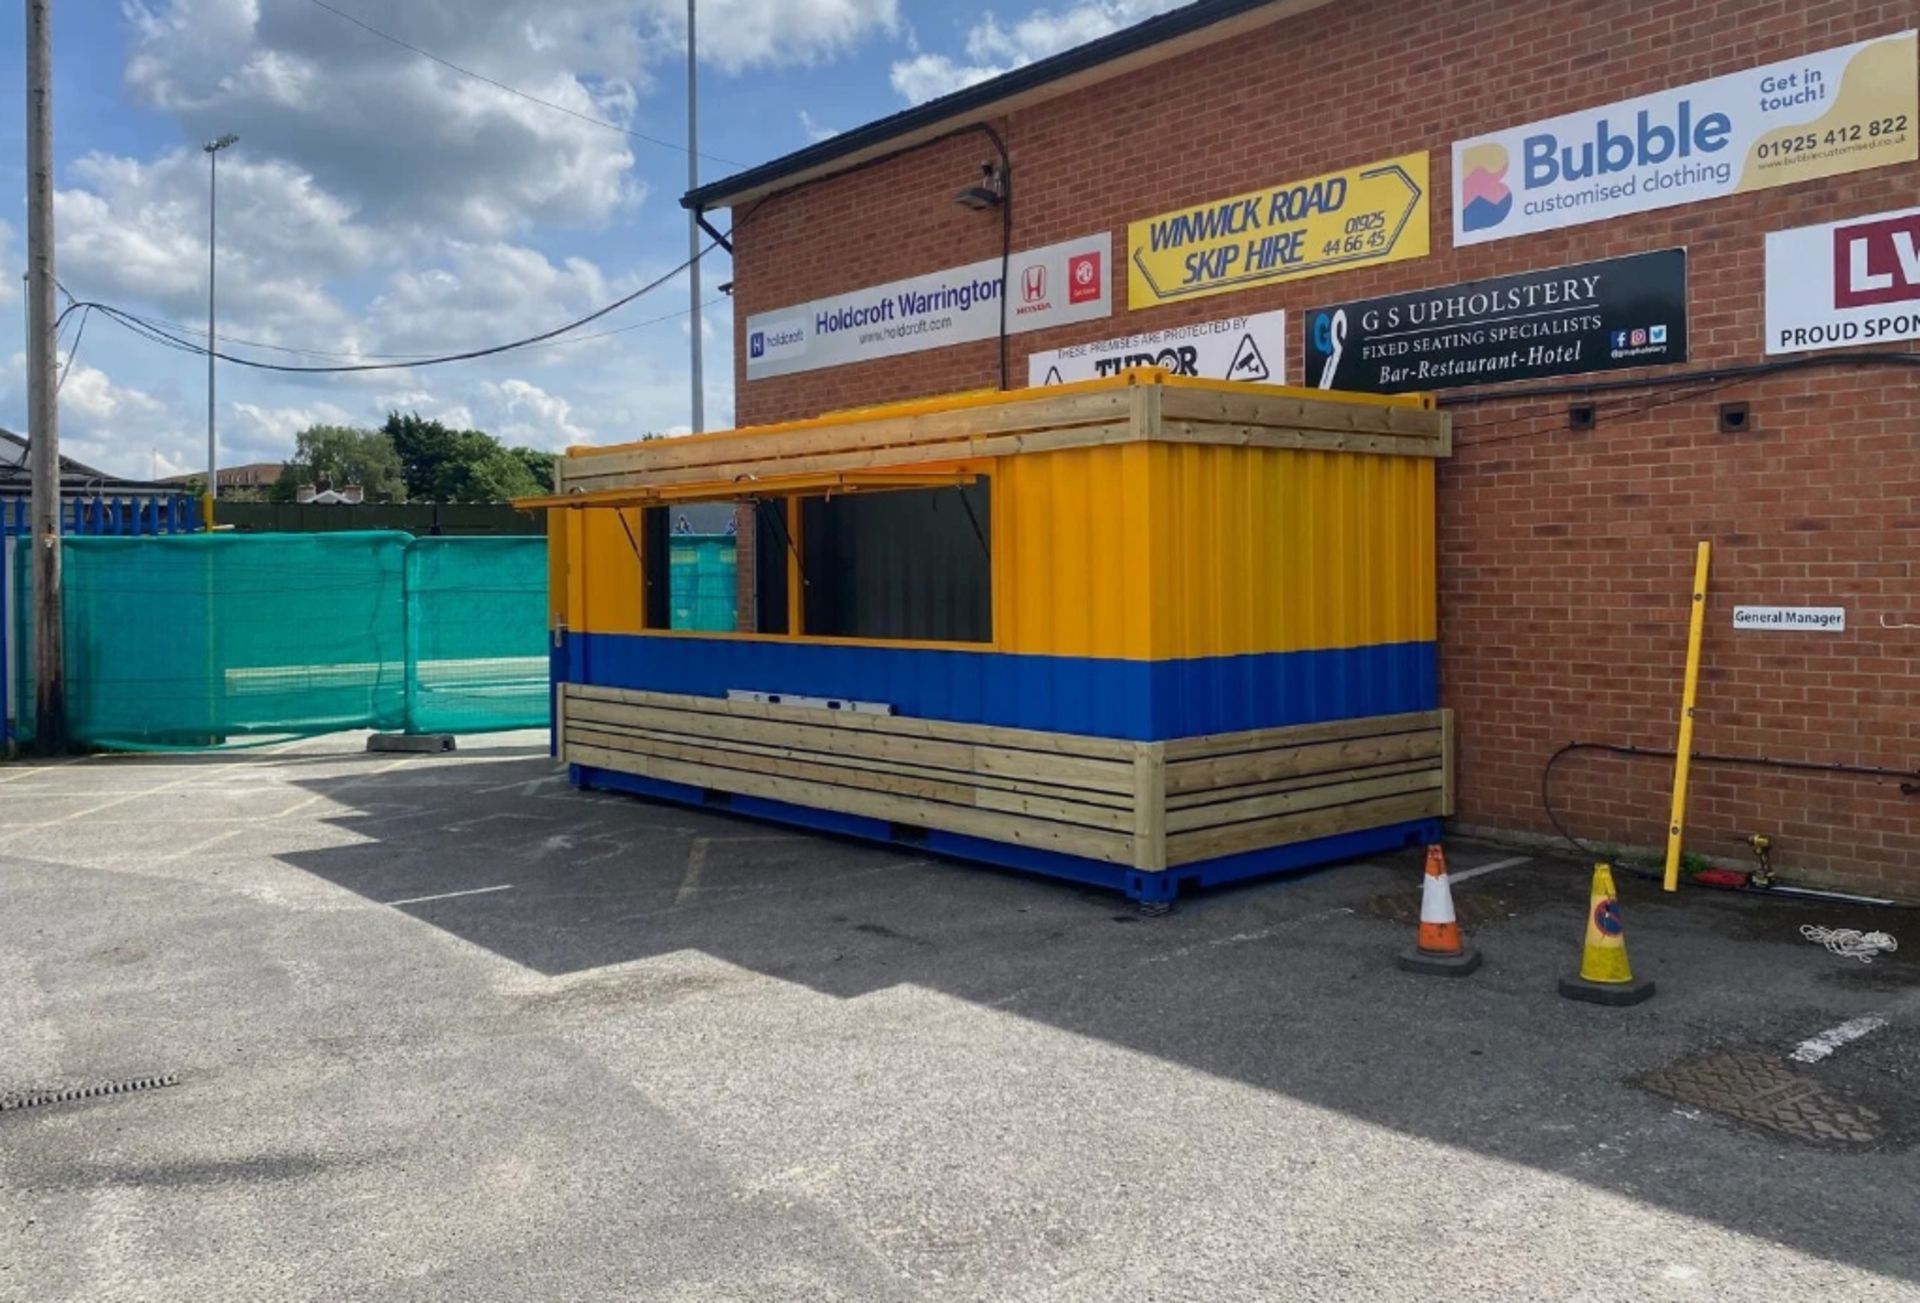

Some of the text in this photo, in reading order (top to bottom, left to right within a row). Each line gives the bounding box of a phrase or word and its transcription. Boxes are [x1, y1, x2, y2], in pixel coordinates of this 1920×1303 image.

[1760, 69, 1821, 93] Get in
[1760, 83, 1825, 112] touch!
[1523, 100, 1732, 190] Bubble
[1757, 115, 1908, 159] 01925 412 822
[1523, 161, 1731, 216] customised clothing
[1150, 177, 1347, 252] WINWICK ROAD
[1345, 210, 1386, 234] 01925
[1183, 229, 1307, 284] SKIP HIRE
[1322, 228, 1386, 256] 44 66 45
[816, 277, 1004, 335] Holdcroft Warrington
[1016, 302, 1052, 315] HONDA
[1362, 275, 1600, 331] G S UPHOLSTERY
[766, 329, 804, 347] holdcroft
[858, 316, 952, 345] www.holdcroft.com
[1058, 317, 1247, 359] THESE PREMISES ARE PROTECTED BY
[1362, 314, 1602, 360] FIXED SEATING SPECIALISTS
[1781, 322, 1858, 347] PROUD
[1379, 340, 1581, 384] Bar-Restaurant-Hotel
[1735, 610, 1841, 627] General Manager
